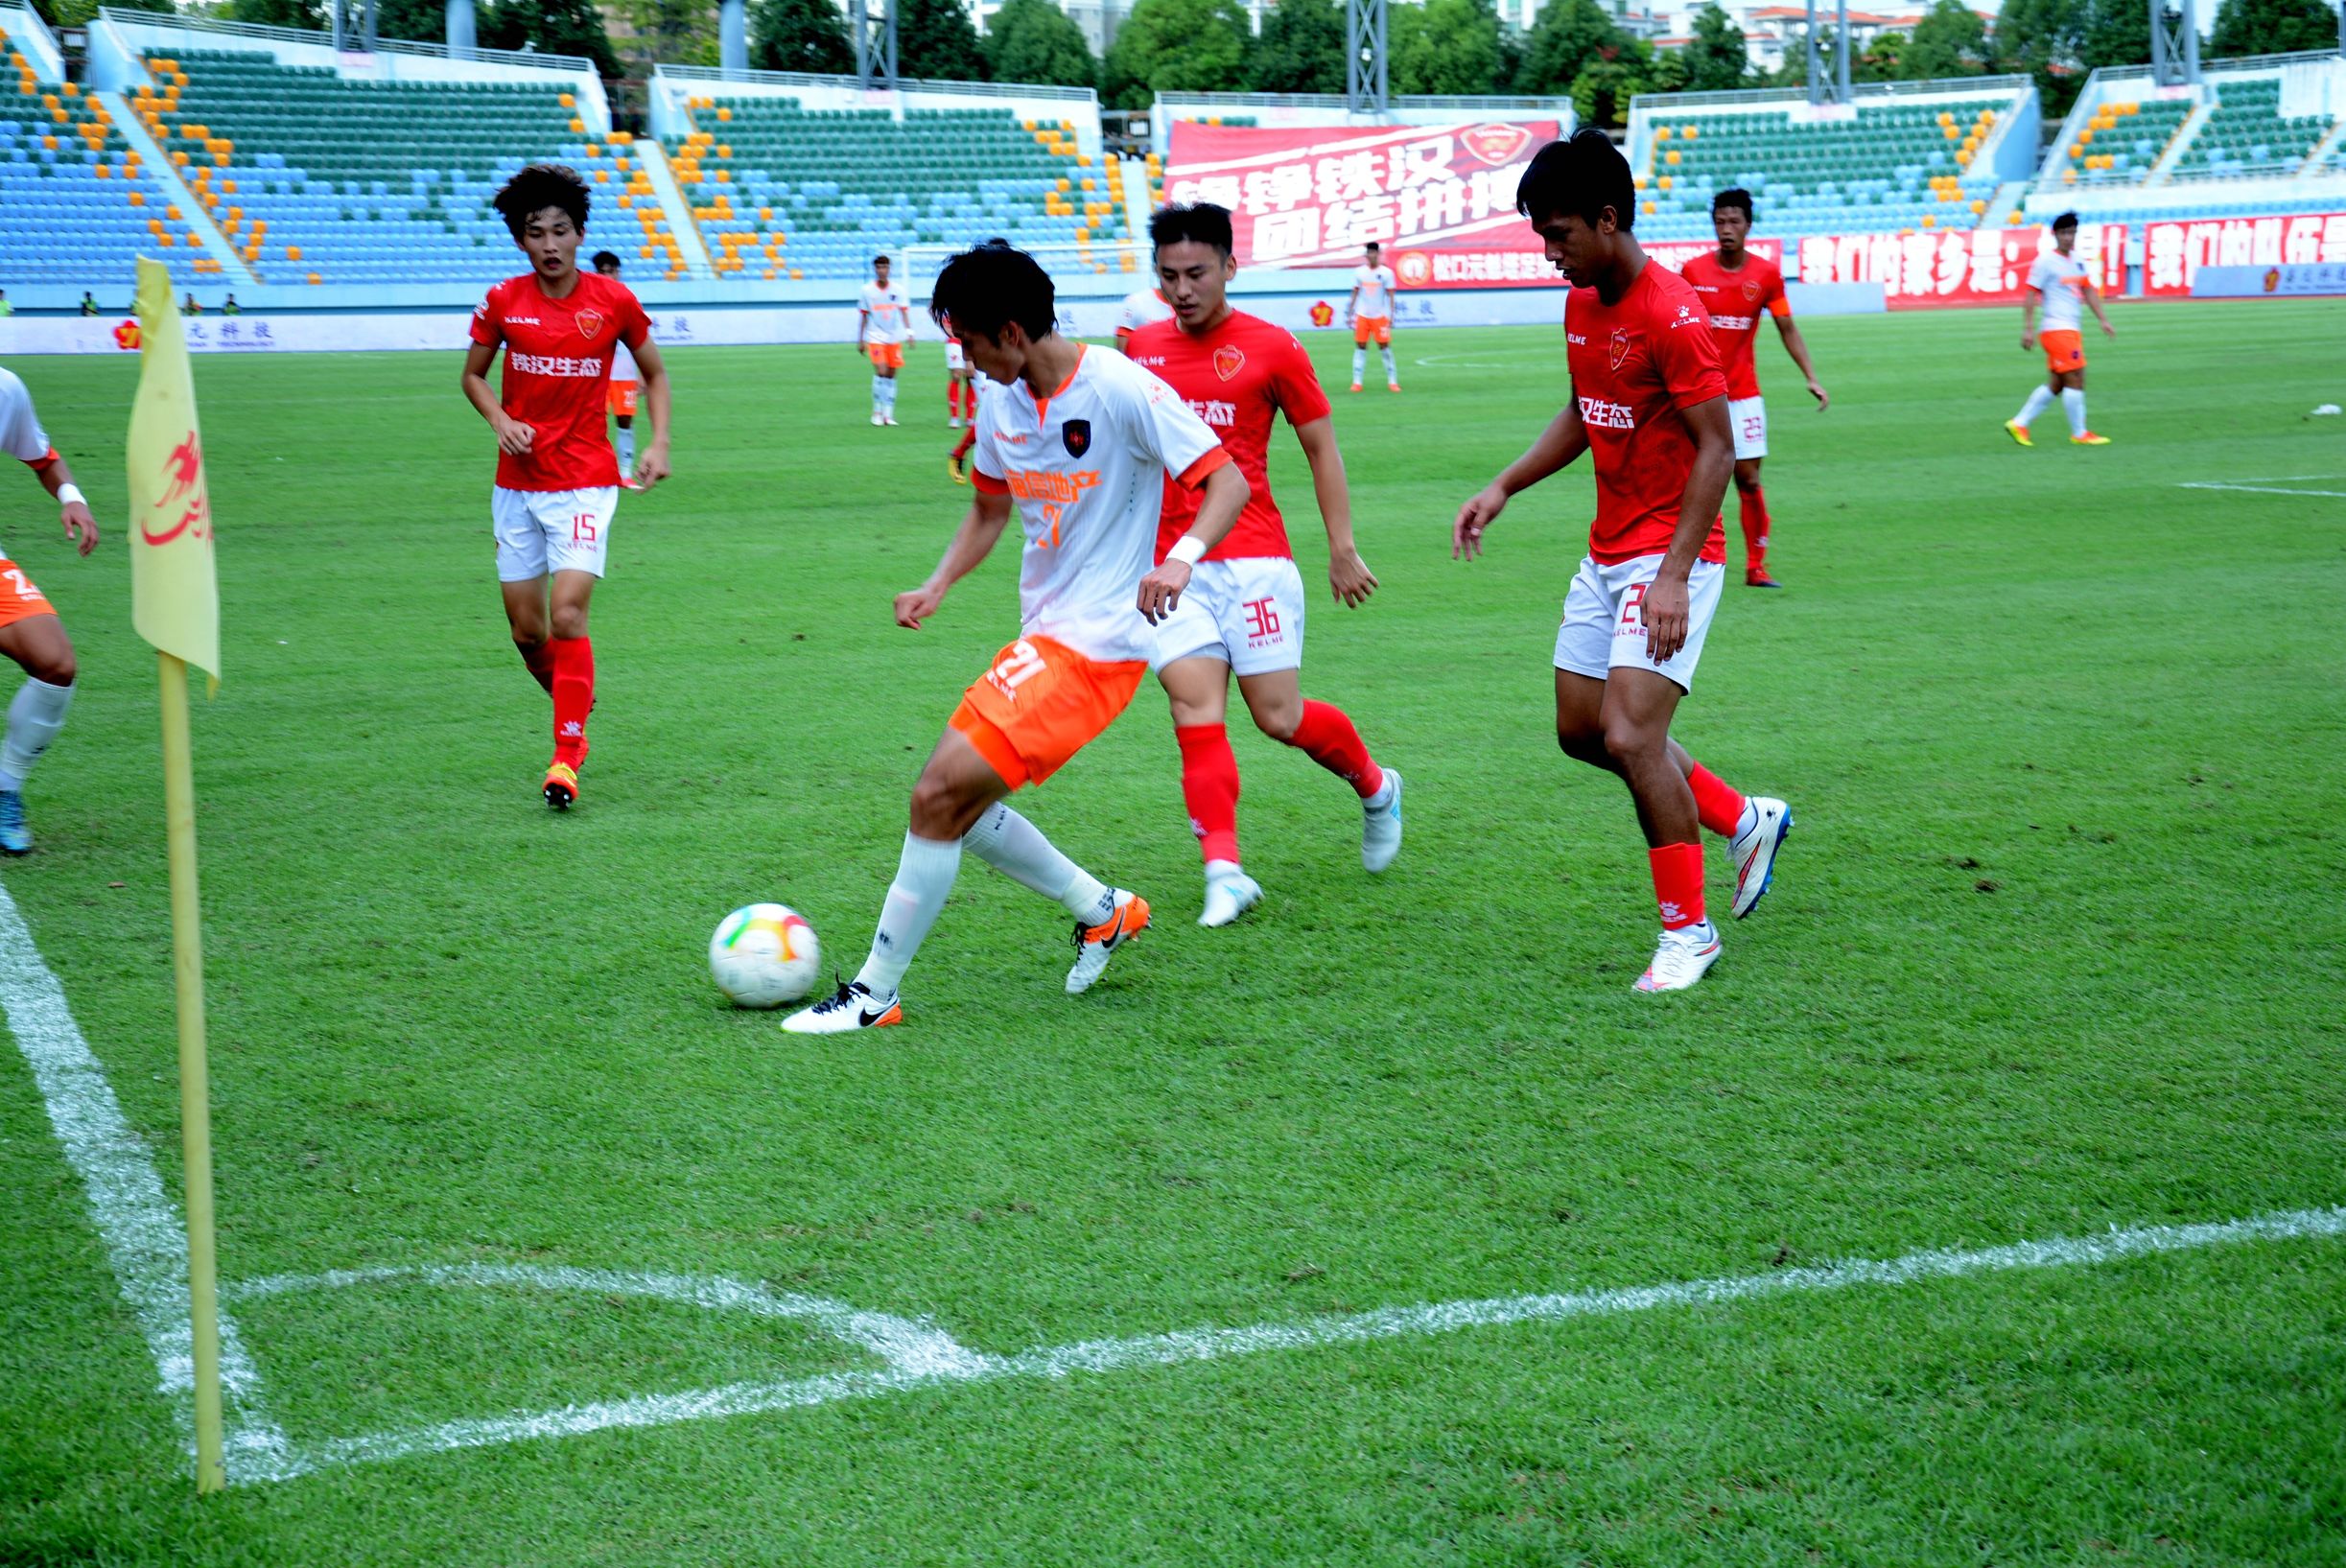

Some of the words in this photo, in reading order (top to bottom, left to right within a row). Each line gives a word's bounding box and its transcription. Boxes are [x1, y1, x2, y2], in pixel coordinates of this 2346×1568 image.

[1169, 134, 1455, 215] 铮铮铁汉
[1568, 333, 1586, 345] ELME
[511, 351, 602, 377] 铁汉生态
[1134, 356, 1165, 366] ELME
[573, 513, 596, 542] 15
[2, 569, 41, 595] 2
[1242, 596, 1280, 639] 36
[997, 640, 1047, 690] 21
